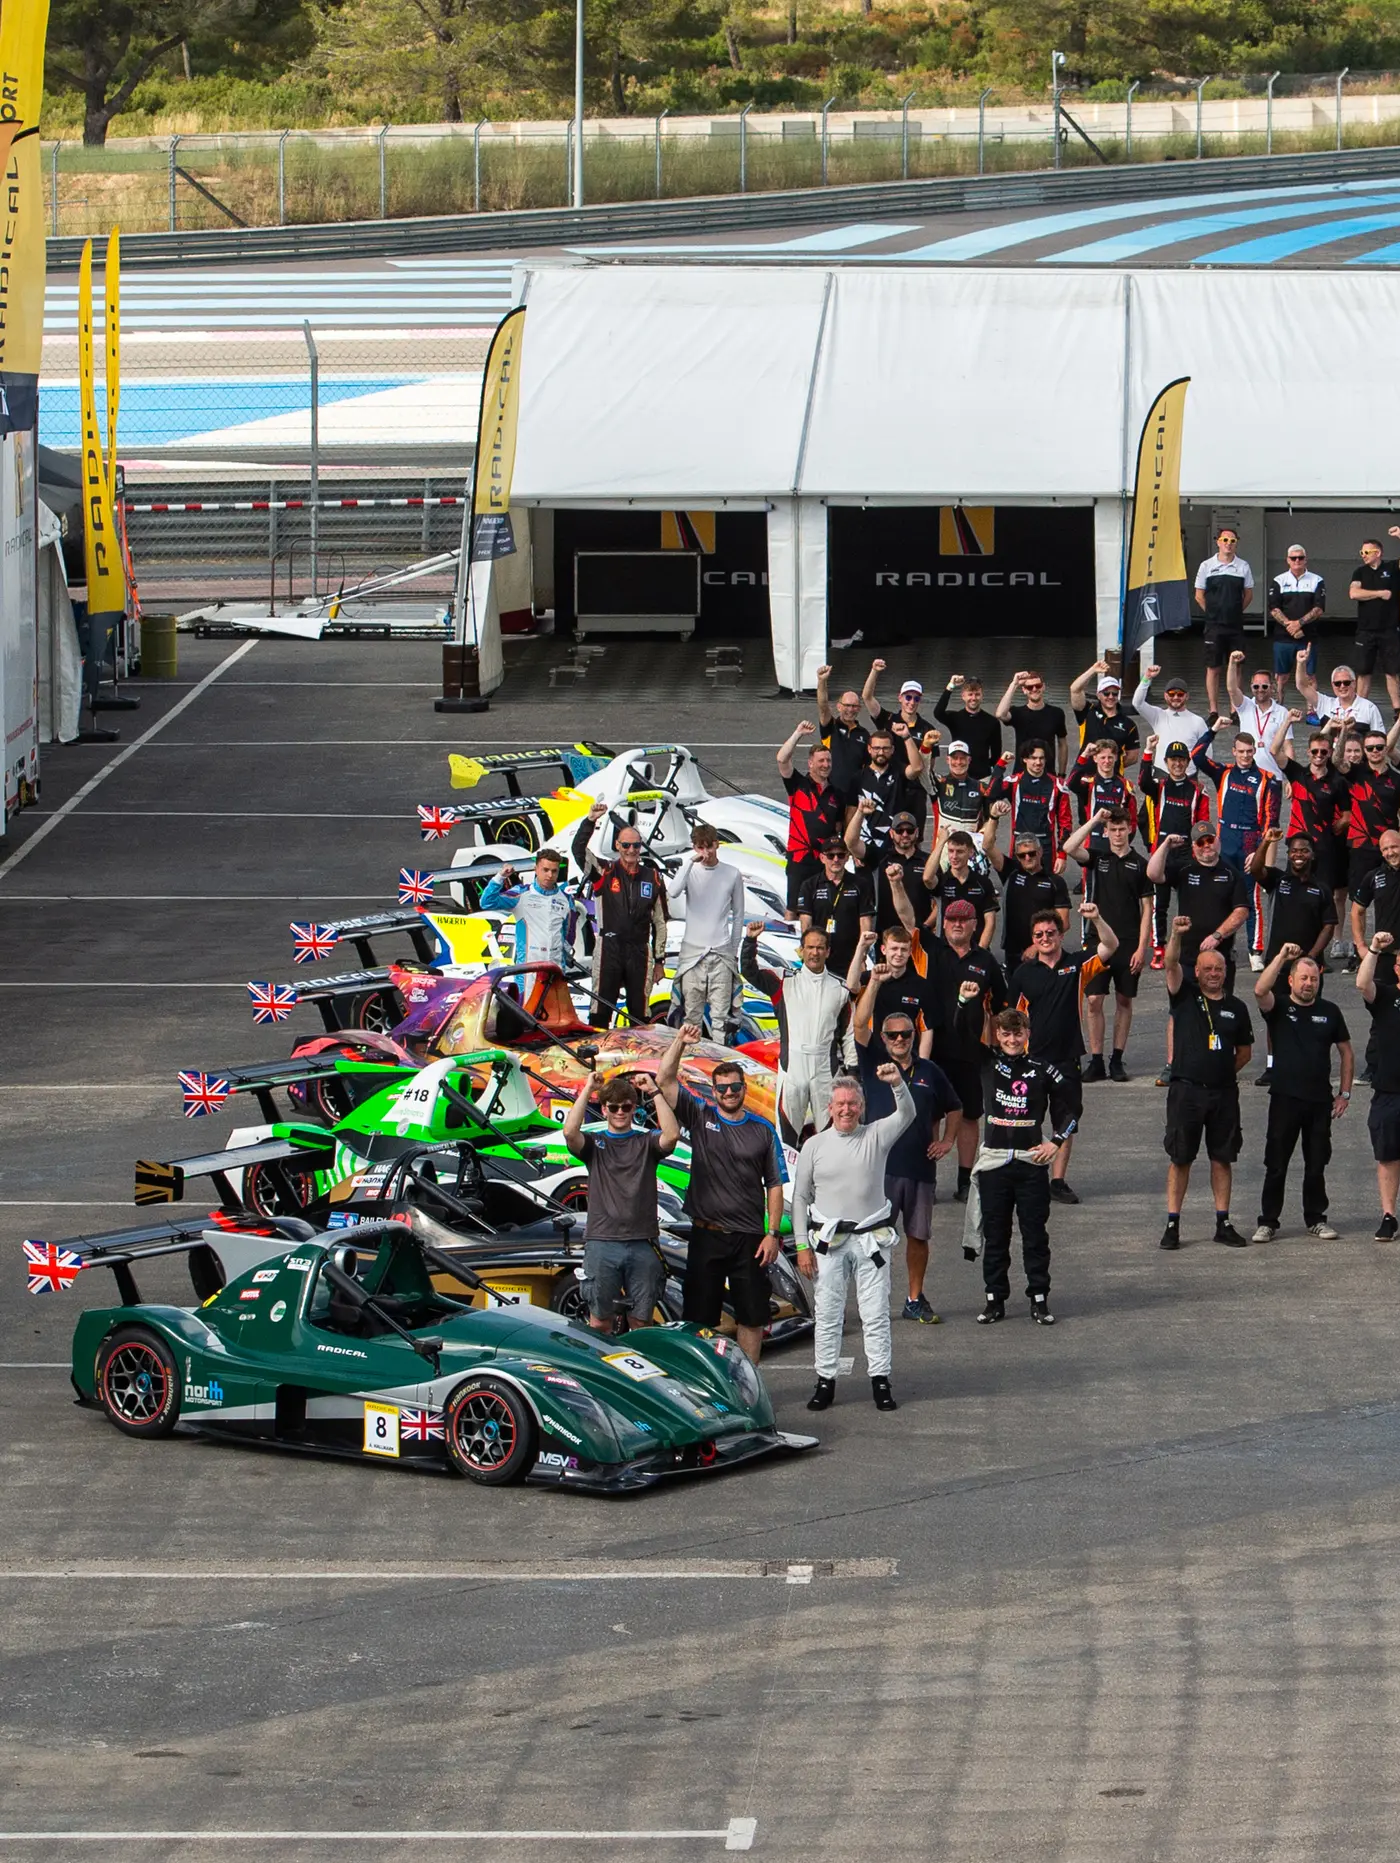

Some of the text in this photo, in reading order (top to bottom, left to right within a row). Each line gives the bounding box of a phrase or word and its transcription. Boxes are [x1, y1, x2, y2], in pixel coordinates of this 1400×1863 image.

[489, 336, 513, 508] RADICAL
[875, 572, 1062, 587] RADICAL
[437, 916, 466, 926] HAGERTY
[404, 1088, 430, 1102] #18
[996, 1092, 1028, 1104] CHANGE
[1001, 1100, 1027, 1109] WORLD
[317, 1344, 368, 1359] RADICAL
[624, 1358, 645, 1370] 8
[547, 1376, 578, 1387] MOTUL
[185, 1397, 223, 1406] MOTORSPORT
[376, 1416, 387, 1439] 8
[538, 1451, 579, 1468] MSVR
